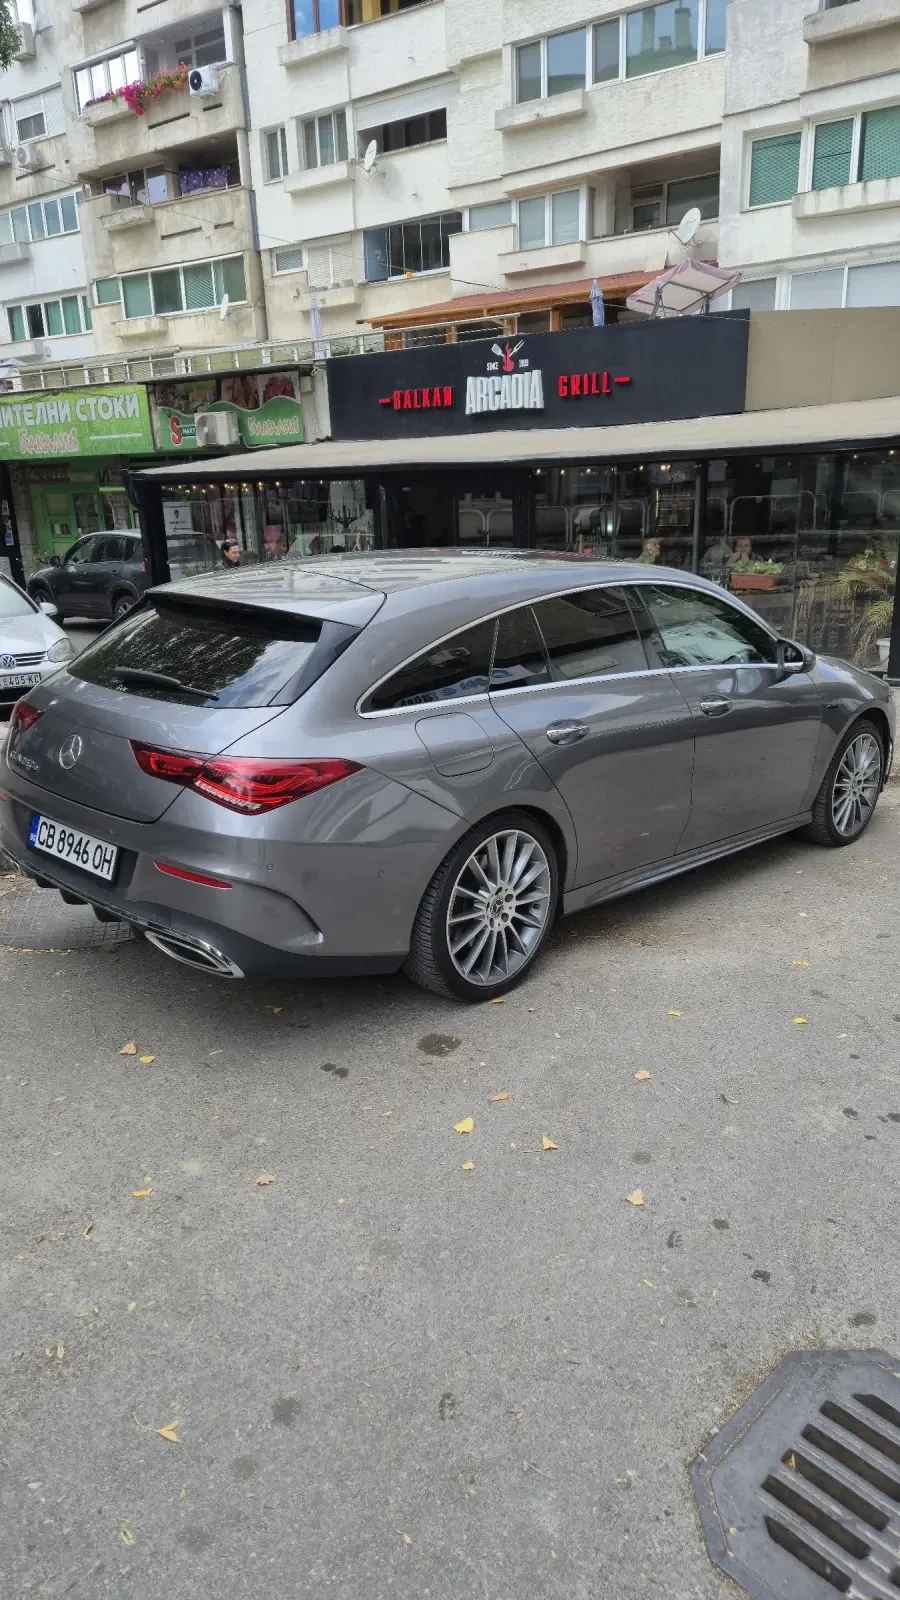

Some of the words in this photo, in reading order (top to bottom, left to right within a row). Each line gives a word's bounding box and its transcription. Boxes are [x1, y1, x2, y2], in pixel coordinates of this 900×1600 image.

[393, 386, 453, 411] BALKAN
[465, 369, 544, 415] ARCADIA
[558, 371, 611, 397] GRILL
[0, 399, 72, 429] ИТЕЛНИ
[75, 393, 140, 422] СТОКИ
[56, 829, 91, 865] 8946
